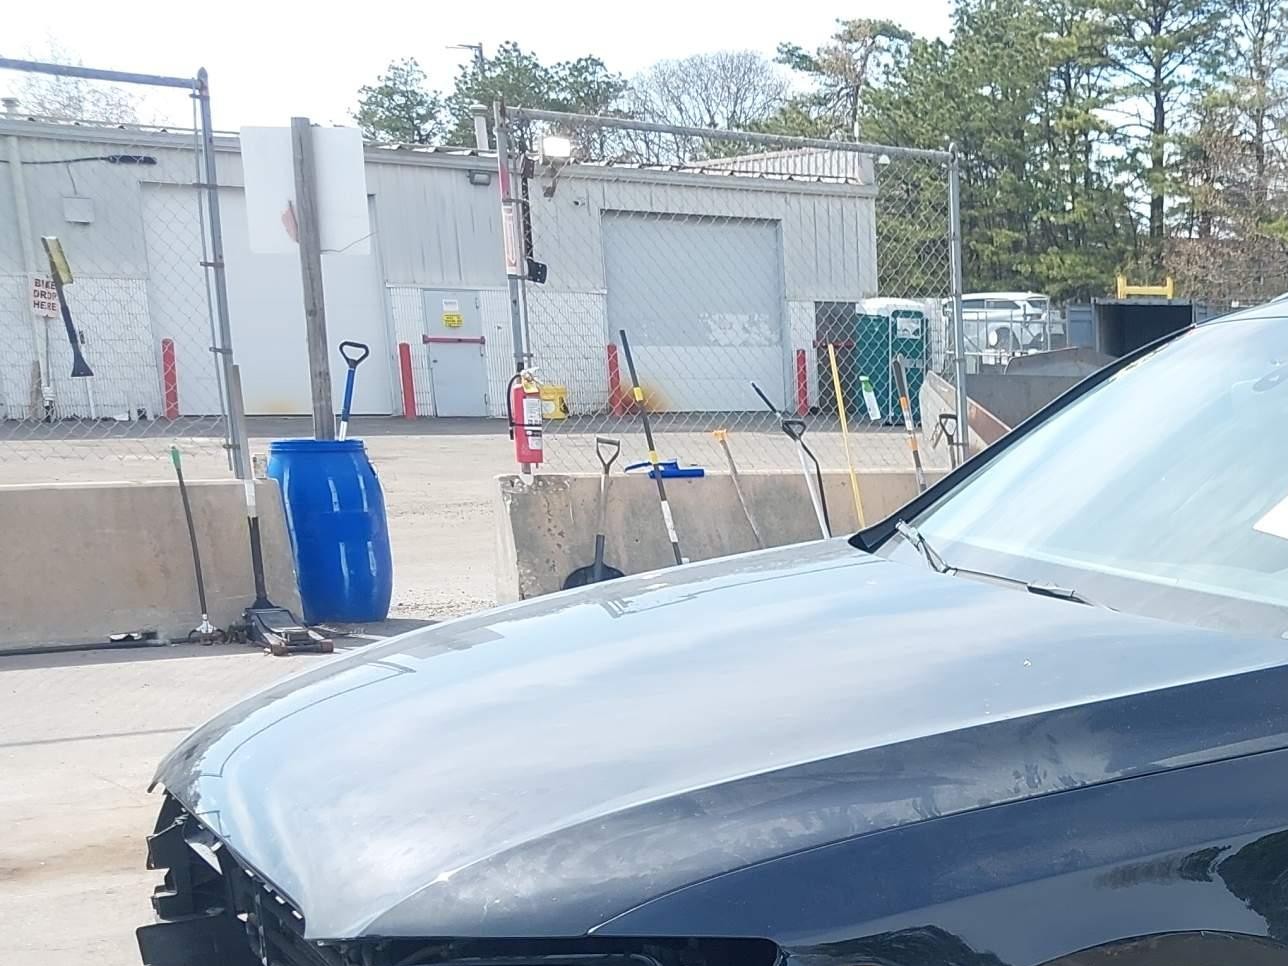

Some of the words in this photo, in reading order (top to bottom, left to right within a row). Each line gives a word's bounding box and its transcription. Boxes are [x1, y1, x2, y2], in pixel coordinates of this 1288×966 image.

[34, 278, 56, 290] BIKE
[33, 289, 57, 301] DROP
[33, 300, 57, 311] HERE
